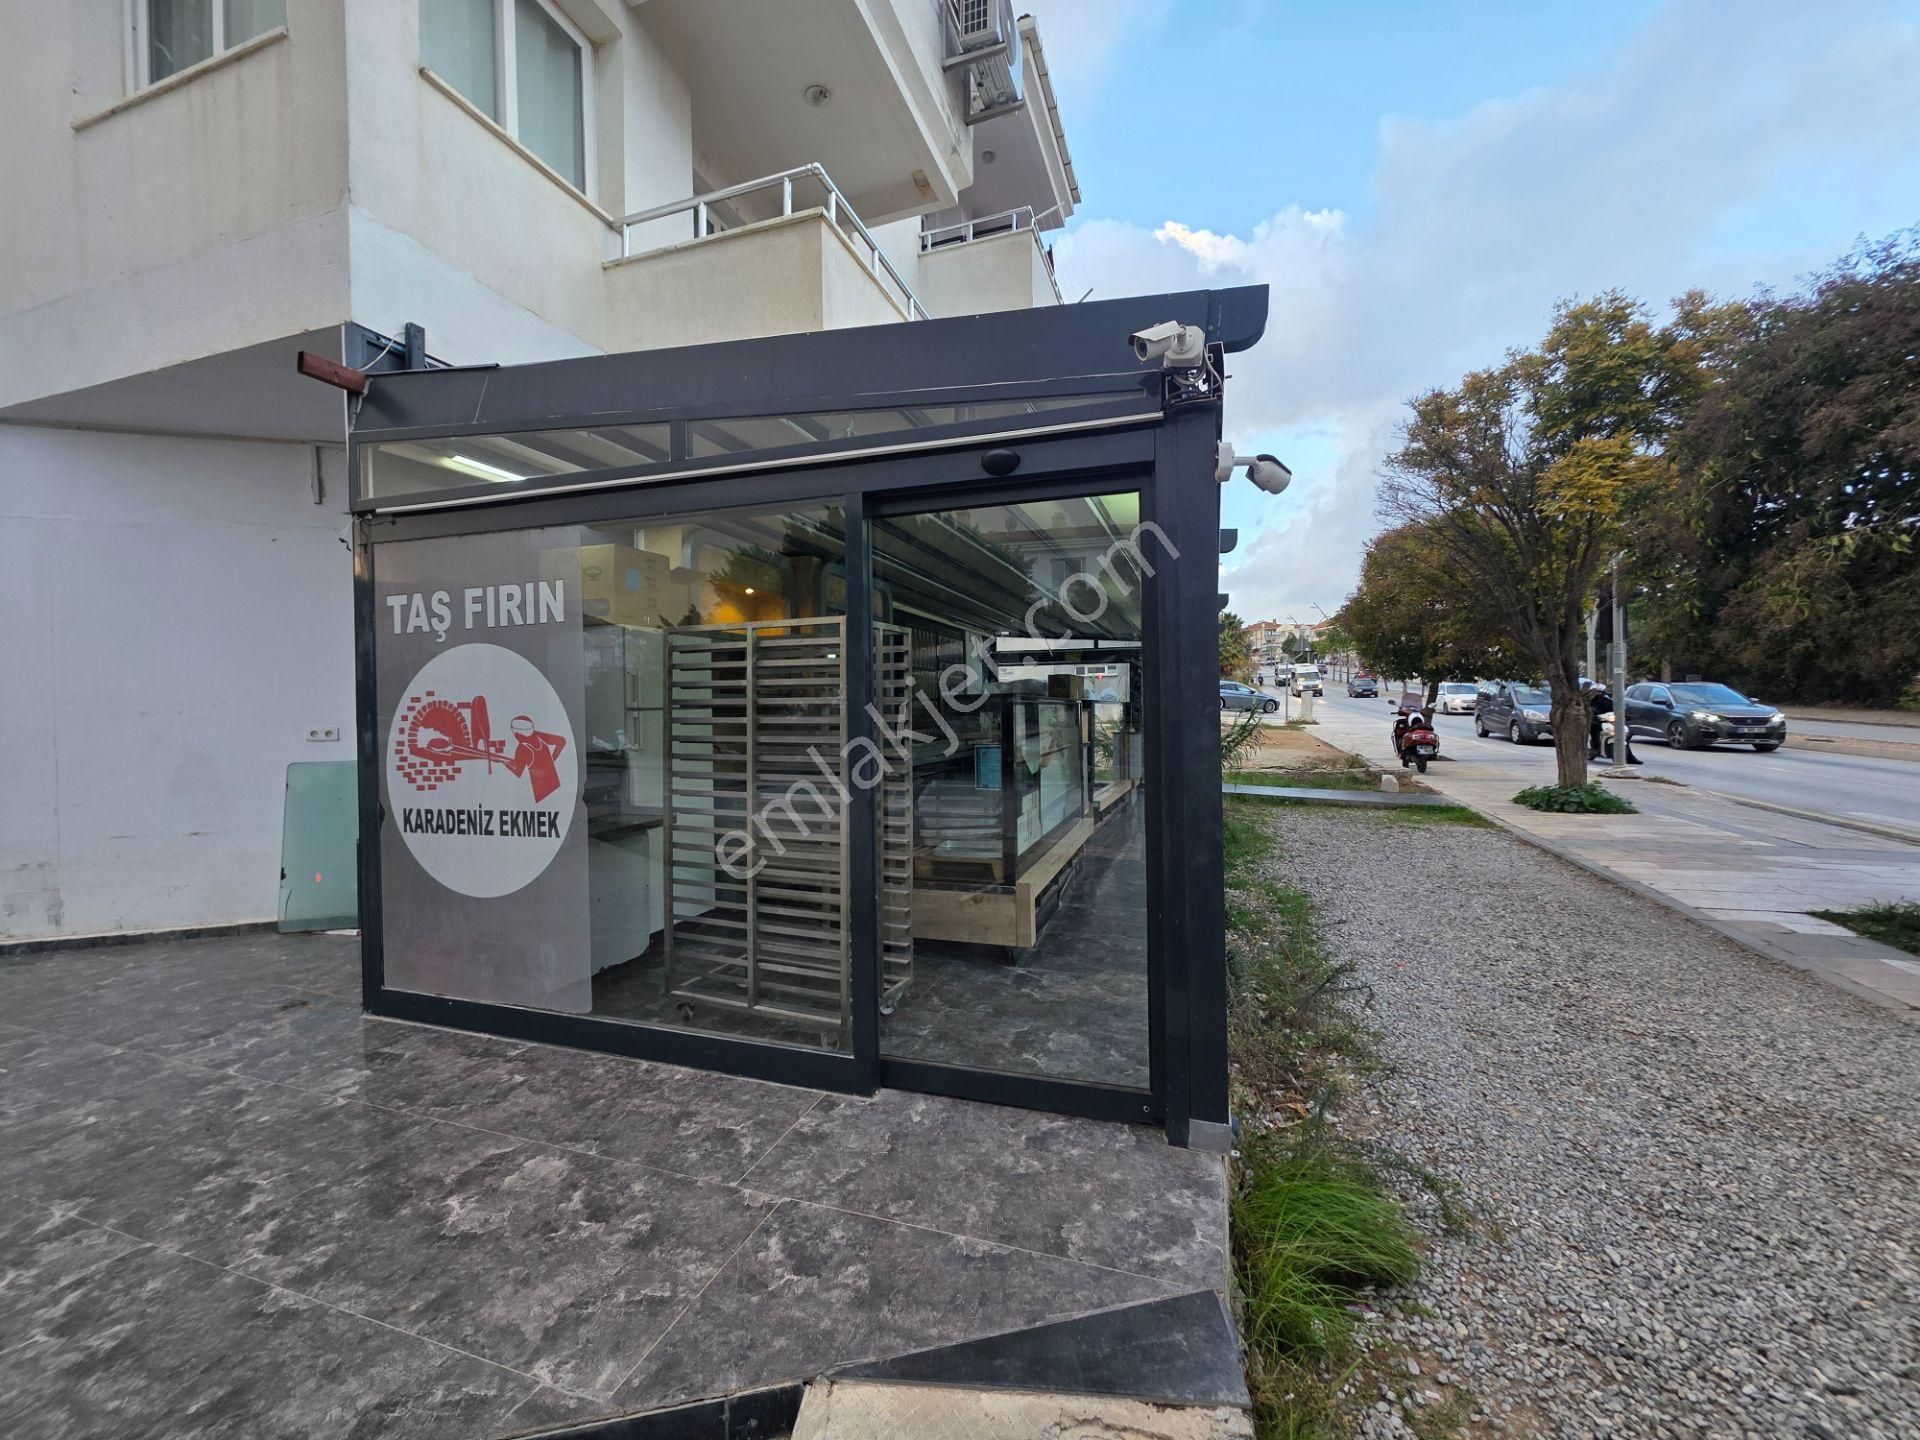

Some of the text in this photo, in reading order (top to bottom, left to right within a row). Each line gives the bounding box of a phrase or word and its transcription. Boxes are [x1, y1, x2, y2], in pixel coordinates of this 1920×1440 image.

[387, 579, 565, 642] TAŞ FIRIN
[403, 803, 560, 839] KARADENİZ EKMEK
